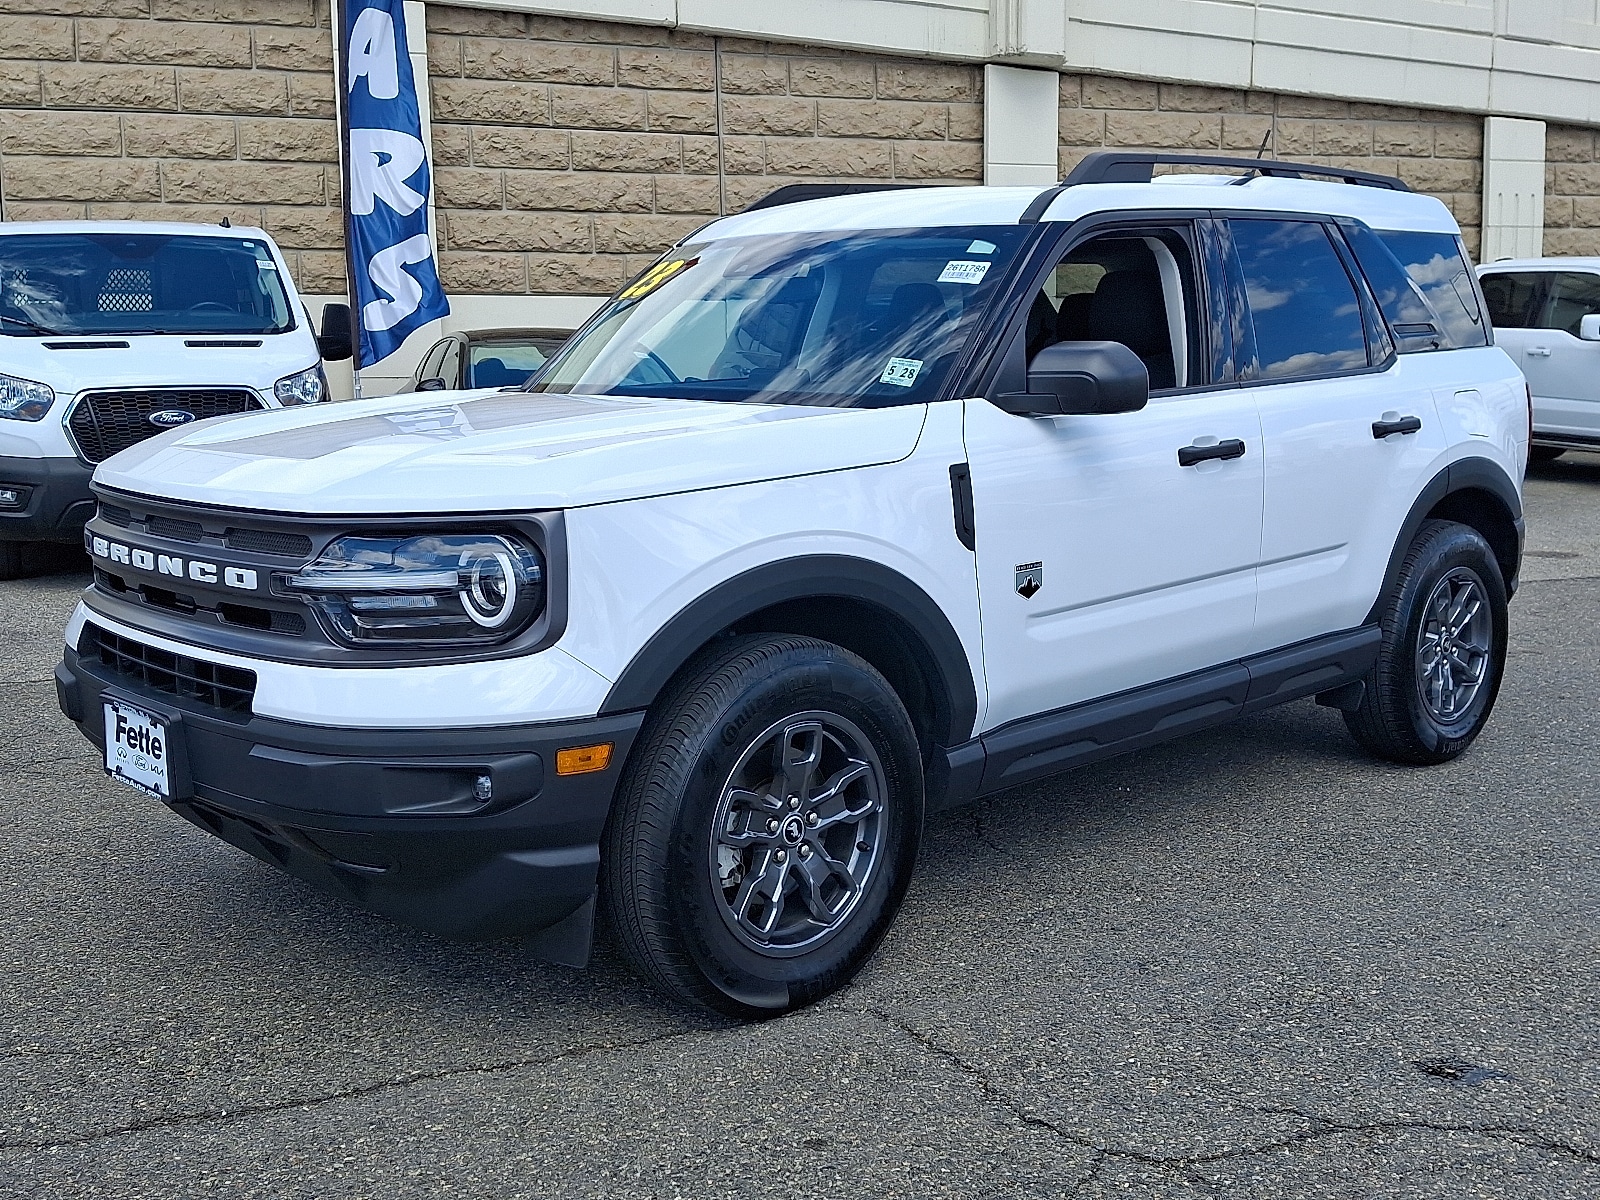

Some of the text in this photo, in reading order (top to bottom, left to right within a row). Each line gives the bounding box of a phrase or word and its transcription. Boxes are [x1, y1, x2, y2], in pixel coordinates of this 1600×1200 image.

[946, 264, 986, 273] 26T178A
[887, 365, 916, 379] 5 28
[93, 536, 258, 590] BRONCO
[115, 713, 163, 760] Fette
